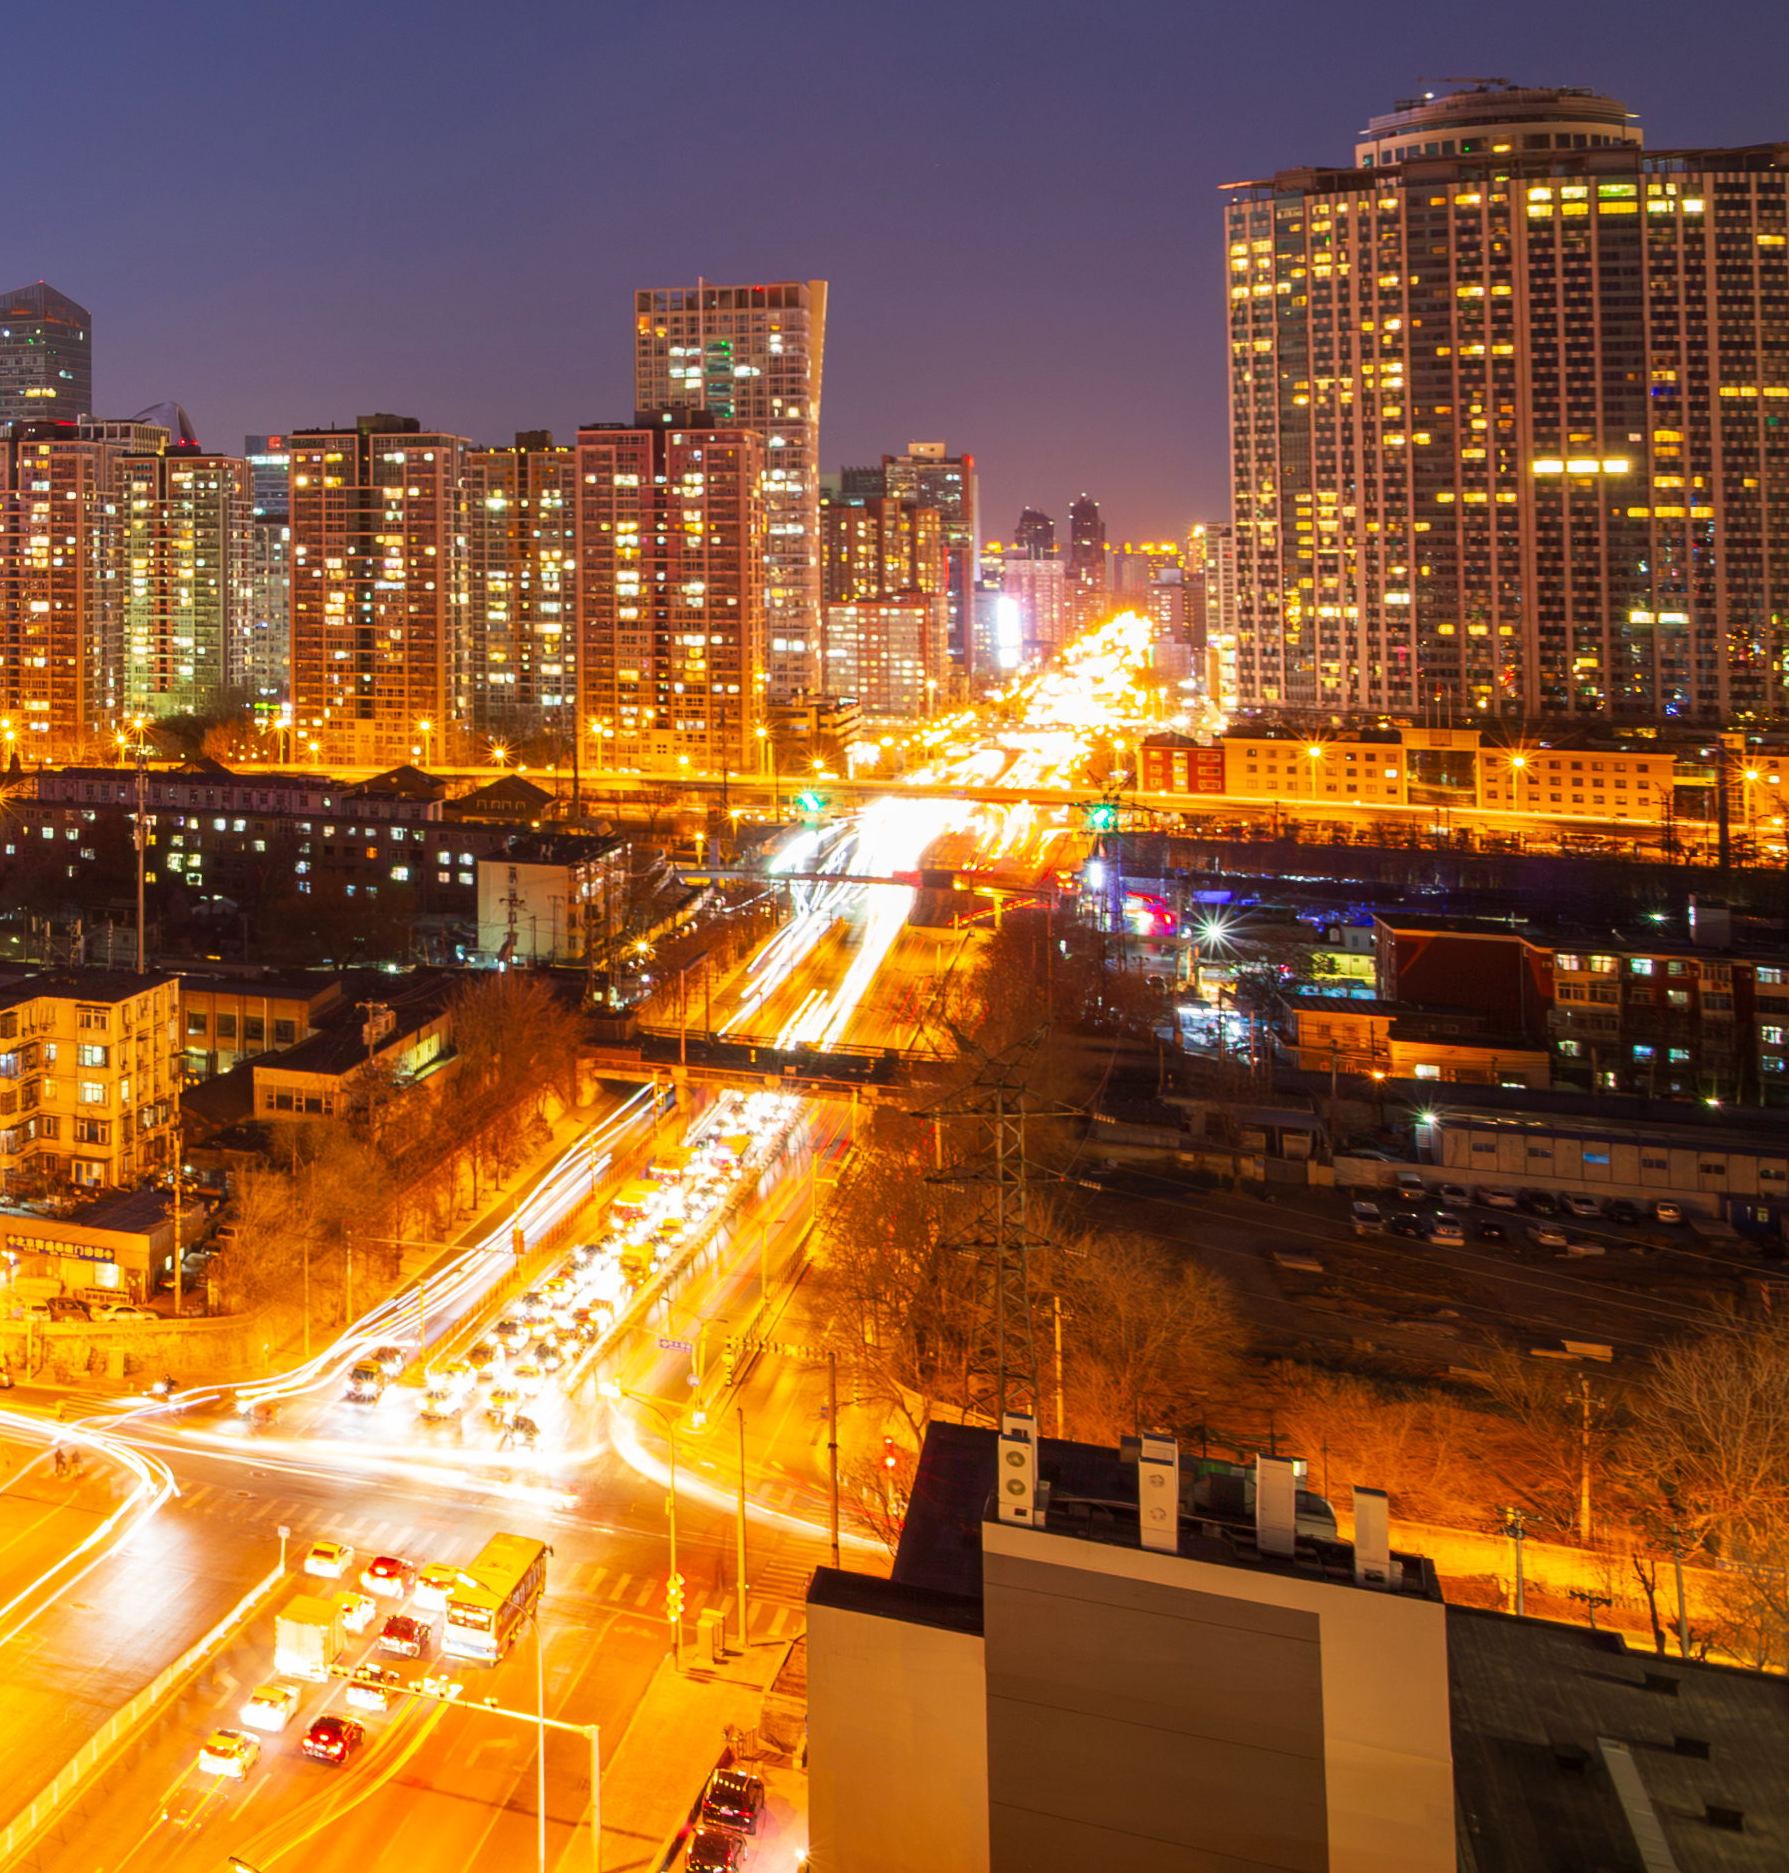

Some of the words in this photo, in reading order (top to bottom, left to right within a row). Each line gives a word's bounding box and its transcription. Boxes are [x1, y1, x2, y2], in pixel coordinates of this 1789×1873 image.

[16, 1236, 104, 1258] 北京门诊部
